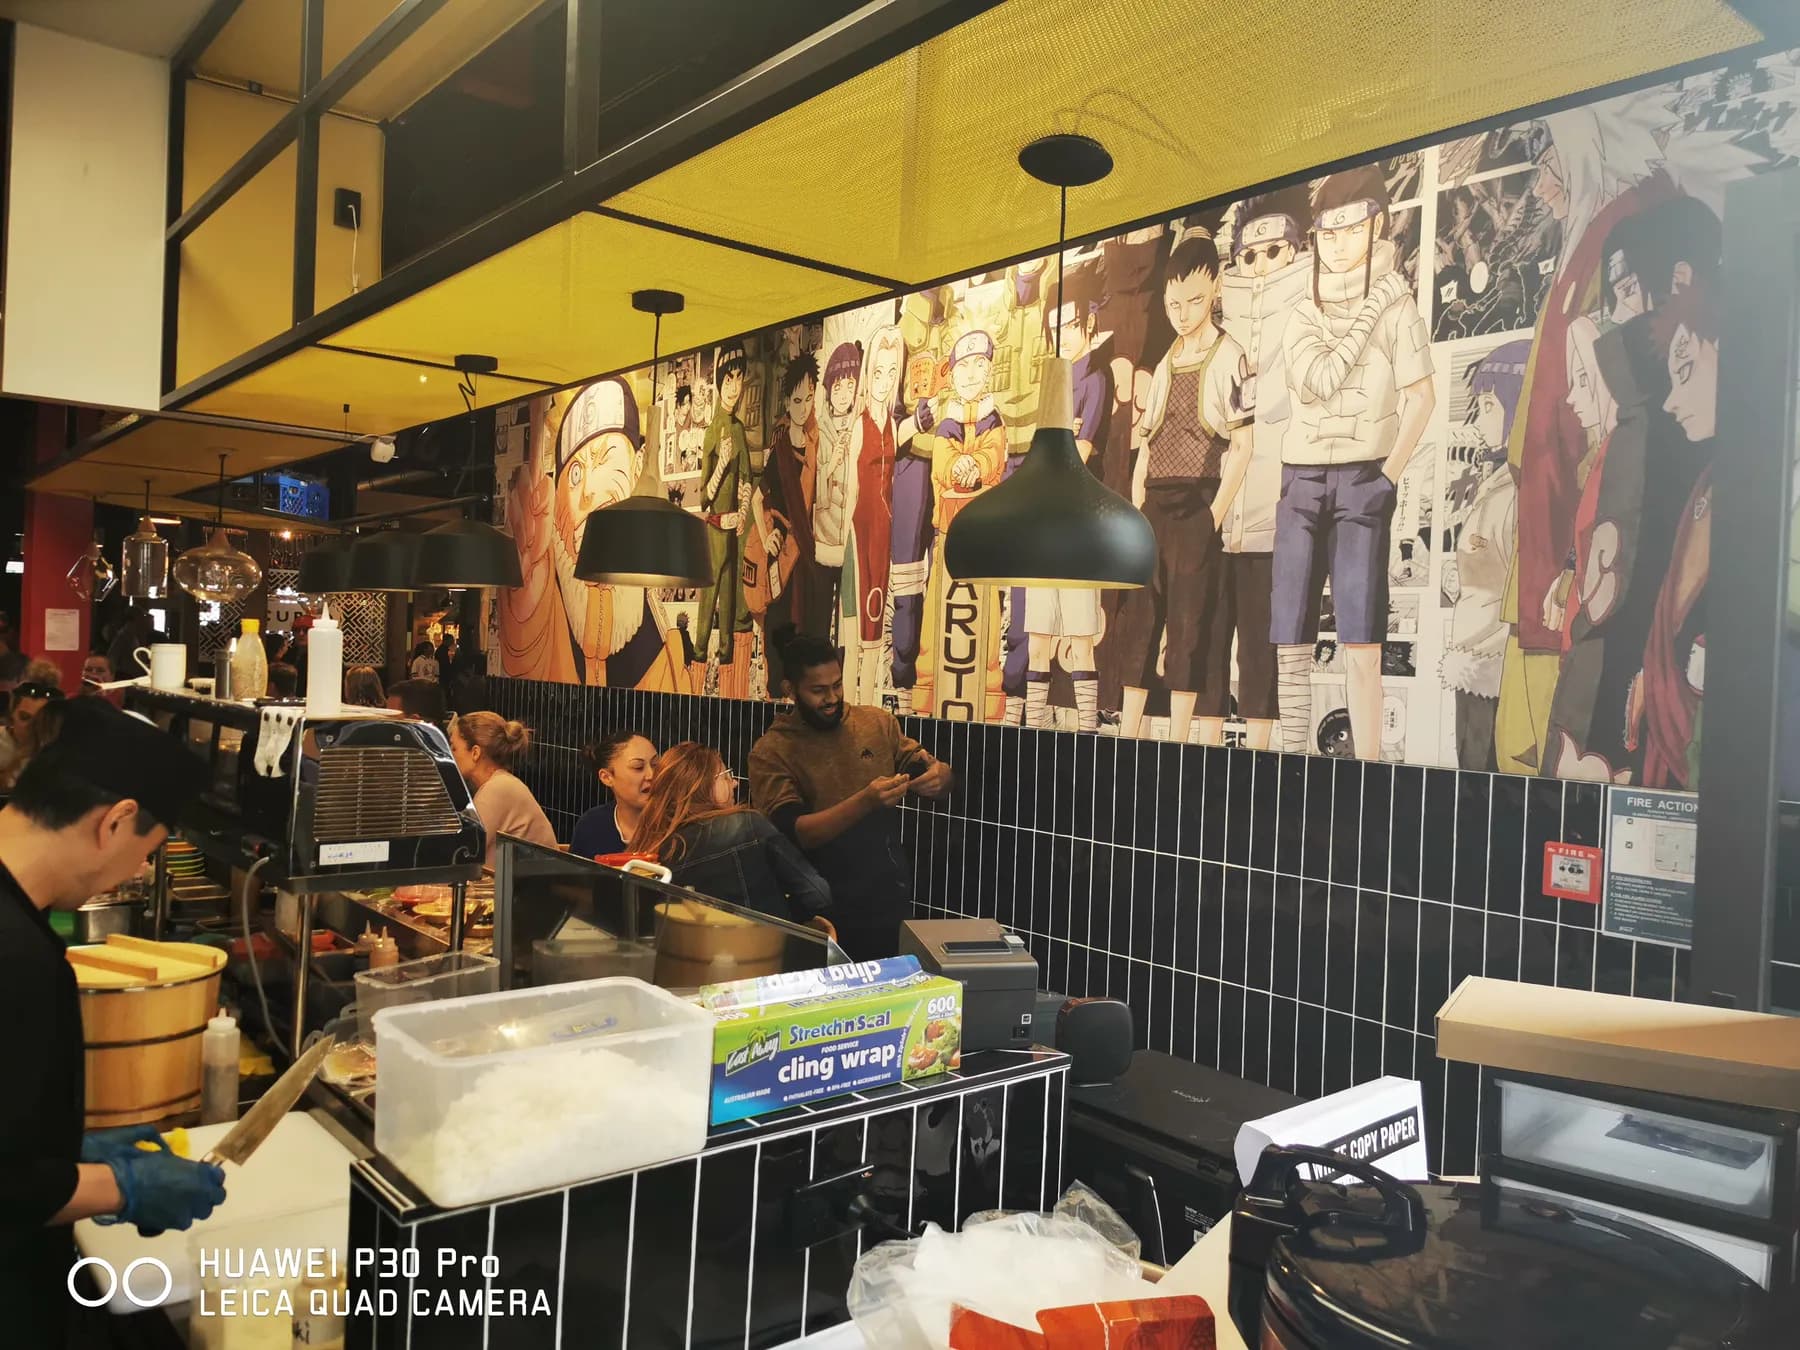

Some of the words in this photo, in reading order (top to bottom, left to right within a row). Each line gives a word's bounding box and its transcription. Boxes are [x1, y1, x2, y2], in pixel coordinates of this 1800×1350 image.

[941, 580, 978, 721] ARUTO
[1626, 796, 1653, 810] FIRE
[1558, 847, 1584, 858] FIRE
[927, 995, 956, 1014] 600
[821, 1044, 838, 1055] FOOD
[838, 1040, 859, 1051] SERVICE
[778, 1055, 835, 1084] cling
[841, 1043, 896, 1070] wrap
[1350, 1129, 1378, 1159] COPY
[1380, 1116, 1416, 1149] PAPER
